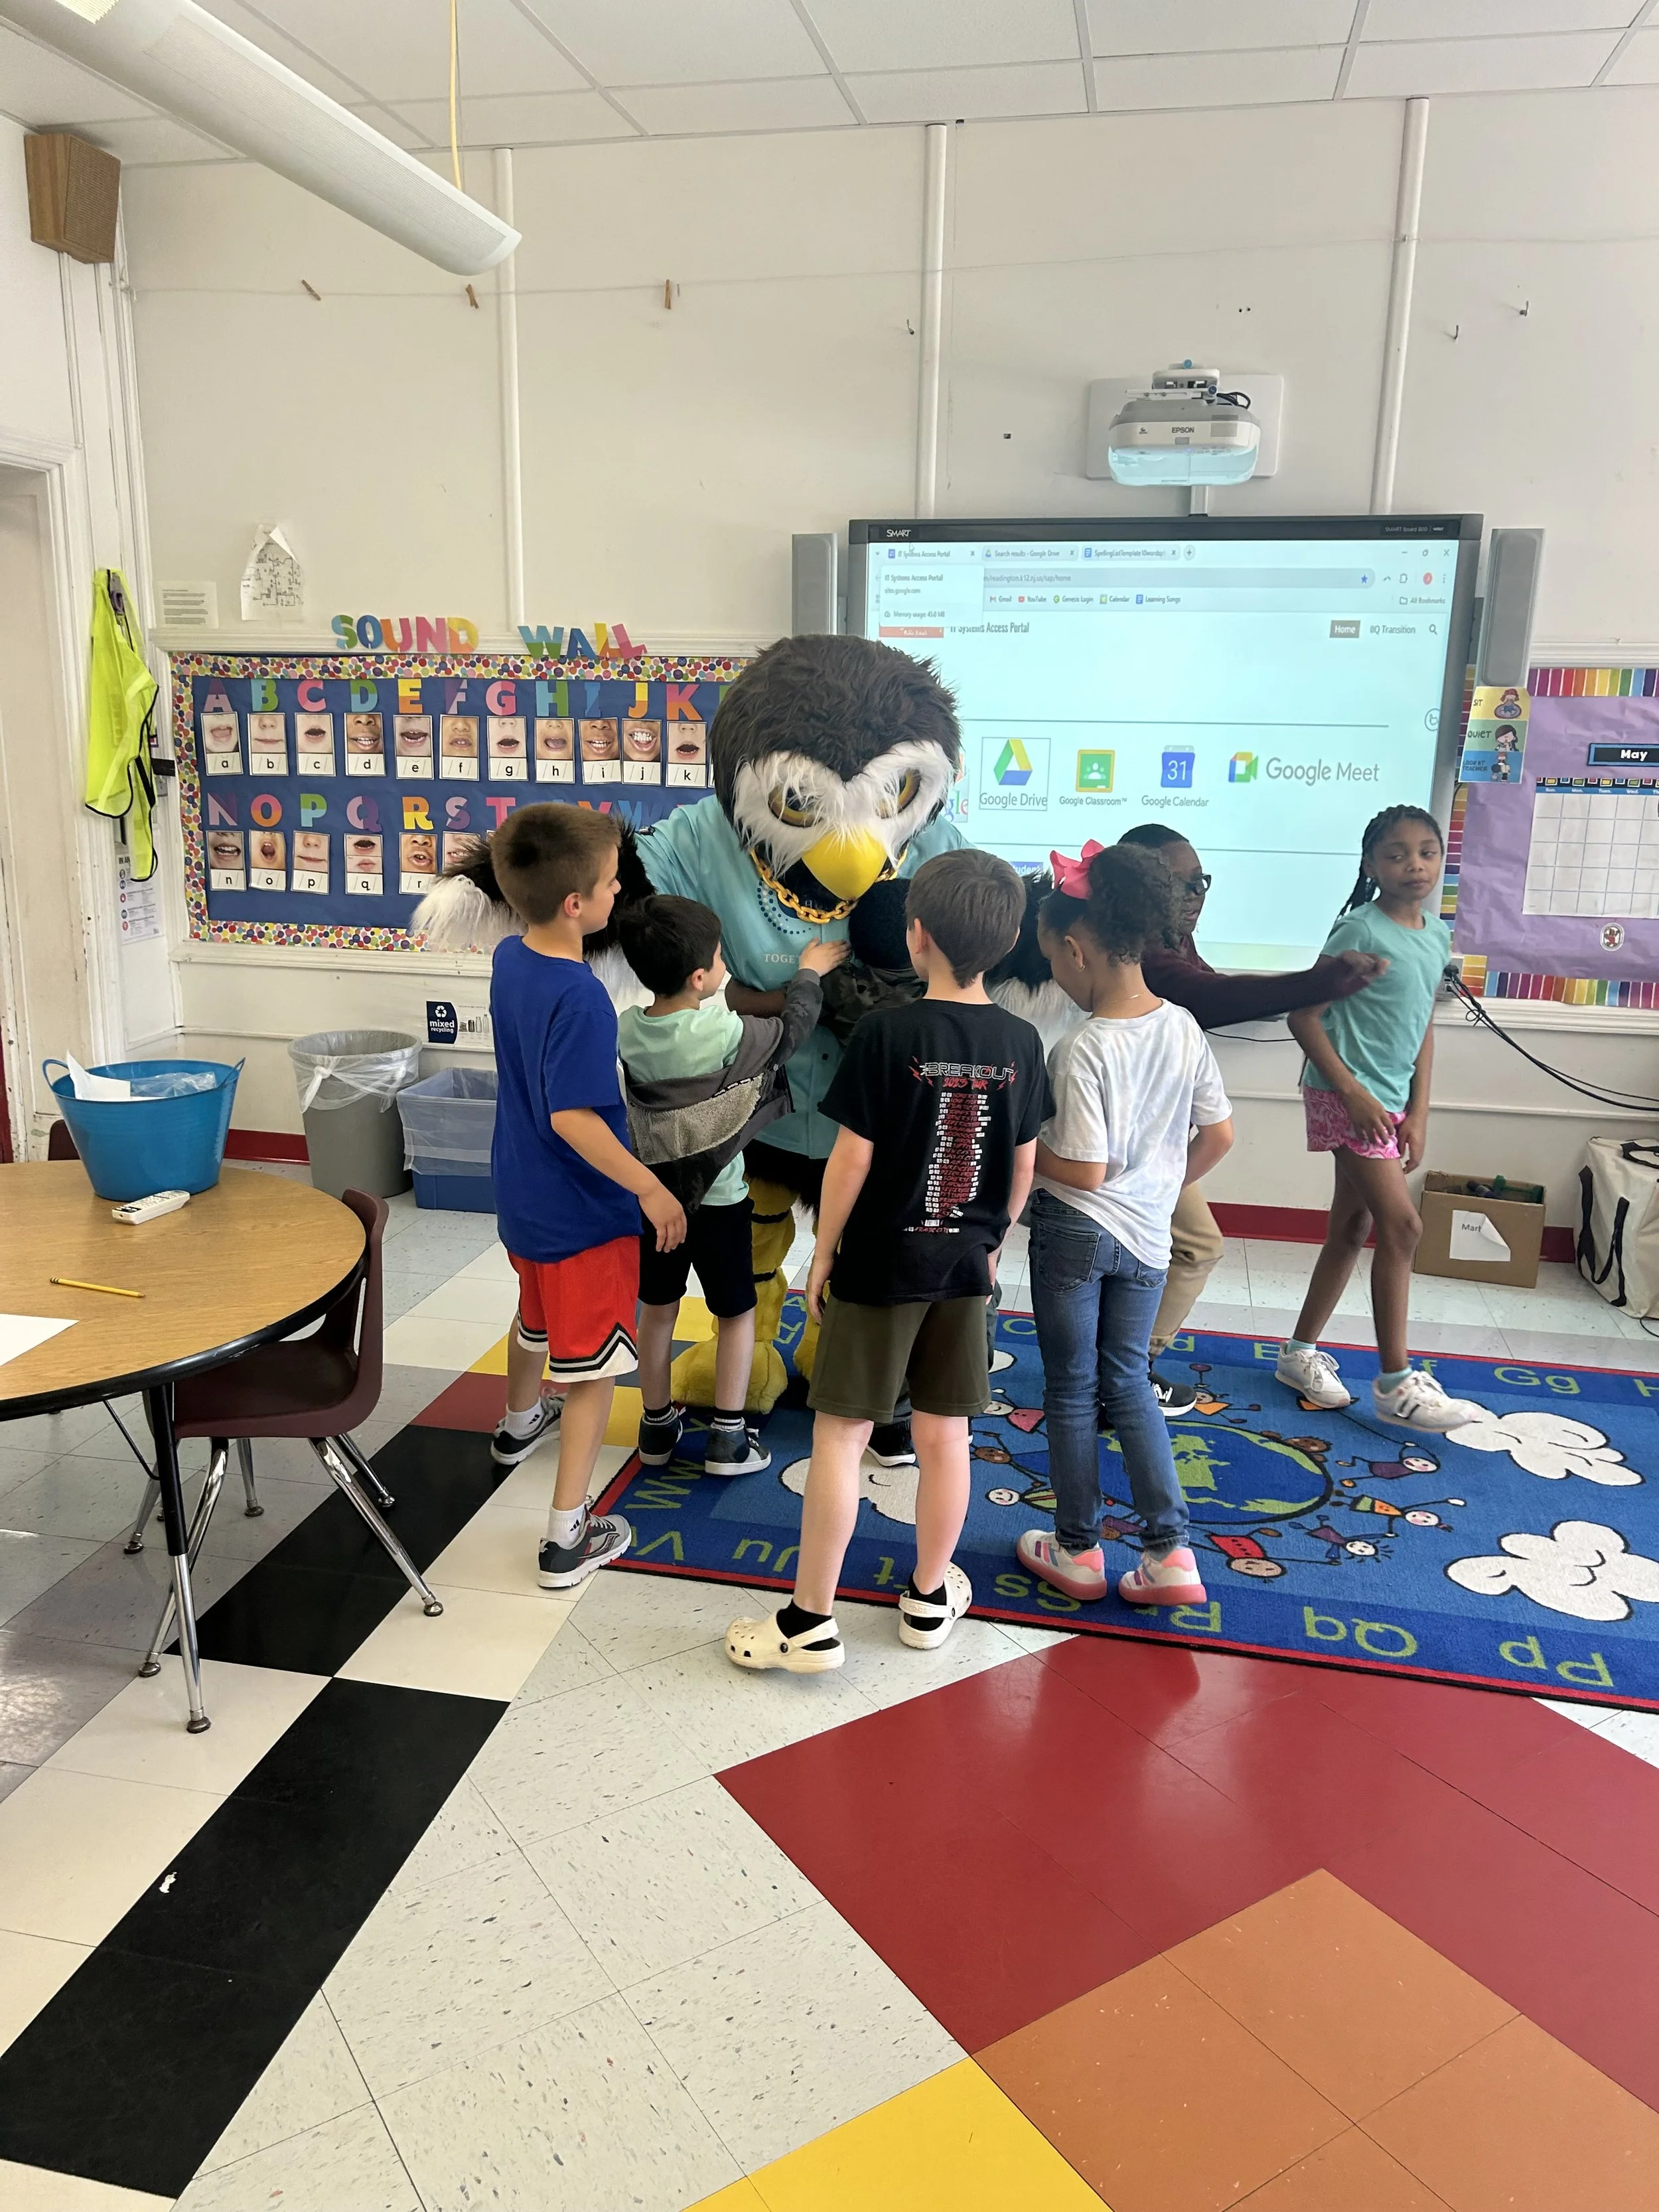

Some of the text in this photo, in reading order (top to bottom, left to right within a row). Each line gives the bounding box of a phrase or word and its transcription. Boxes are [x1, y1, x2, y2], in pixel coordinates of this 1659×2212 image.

[1030, 550, 1046, 559] Google
[1145, 596, 1165, 605] Learning
[1166, 596, 1181, 605] Songs
[986, 622, 1008, 633] Access
[1010, 622, 1029, 633] Portal
[1334, 625, 1356, 634] Home
[1382, 625, 1415, 634] Transition
[332, 615, 647, 660] SOUND WALL
[204, 678, 232, 713] A
[251, 678, 279, 713] B
[297, 680, 326, 712] C
[350, 680, 378, 713] D
[398, 678, 423, 713] E
[485, 680, 516, 715] G
[535, 680, 569, 717] H
[584, 682, 601, 717] I
[628, 682, 648, 719] J
[666, 684, 703, 721] K
[1621, 749, 1648, 761] May
[1167, 760, 1187, 781] 31
[1266, 757, 1380, 786] Google Meet
[979, 792, 1048, 808] Google Drive
[1059, 796, 1083, 806] Google
[1141, 795, 1210, 808] Google Calendar
[208, 792, 238, 826] N
[250, 794, 283, 828] O
[300, 793, 327, 828] P
[346, 796, 382, 832] Q
[401, 796, 434, 830] R
[445, 796, 471, 830] S
[764, 954, 799, 964] TOGE
[429, 1019, 455, 1028] mixed
[920, 1062, 1014, 1082] BREAKOUT
[1002, 1318, 1037, 1335] C
[1254, 1343, 1279, 1361] E
[1494, 1366, 1581, 1394] Gg
[1303, 1606, 1418, 1658] Qq
[1499, 1636, 1614, 1688] Pp
